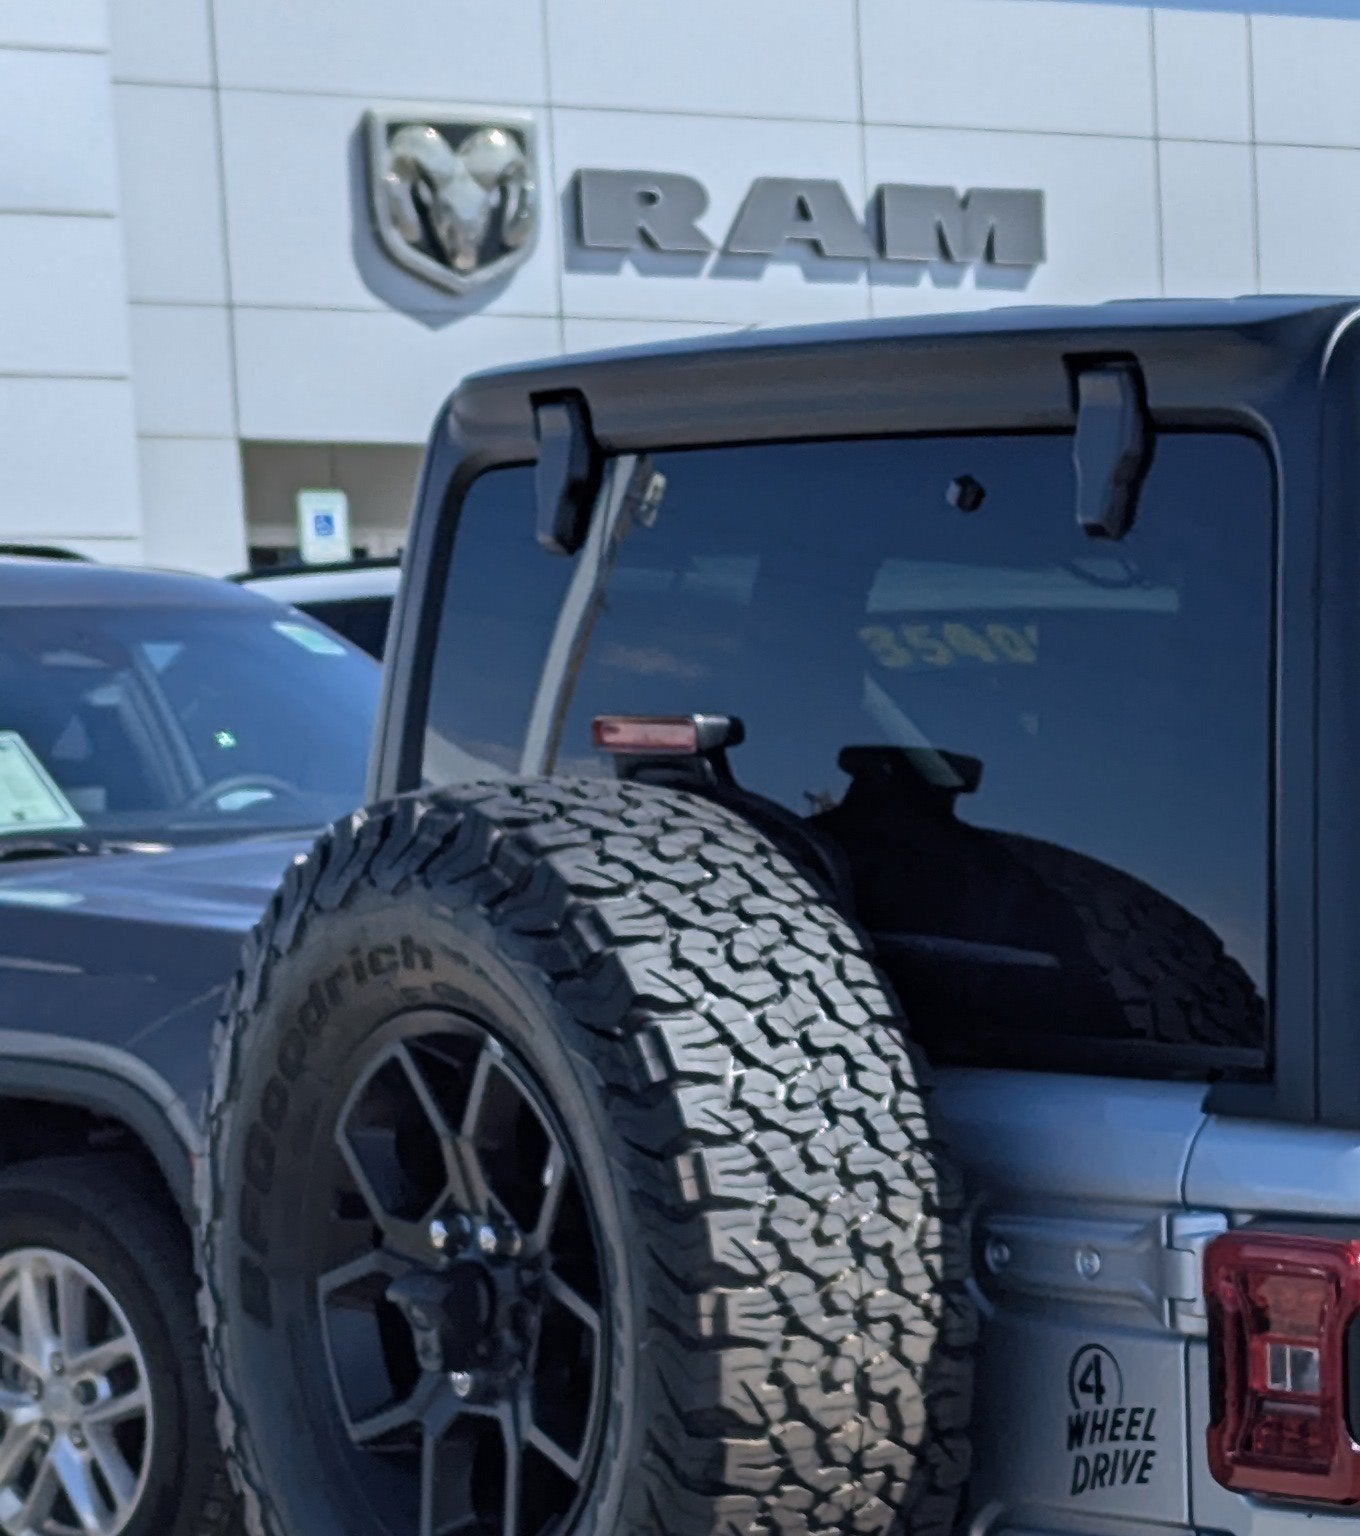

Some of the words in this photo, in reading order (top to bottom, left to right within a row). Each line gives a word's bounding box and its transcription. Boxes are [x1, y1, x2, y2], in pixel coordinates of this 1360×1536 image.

[574, 168, 1046, 266] RAM
[1079, 1354, 1106, 1405] 4
[1067, 1407, 1157, 1451] WHEEL
[1070, 1450, 1157, 1496] DRIVE
